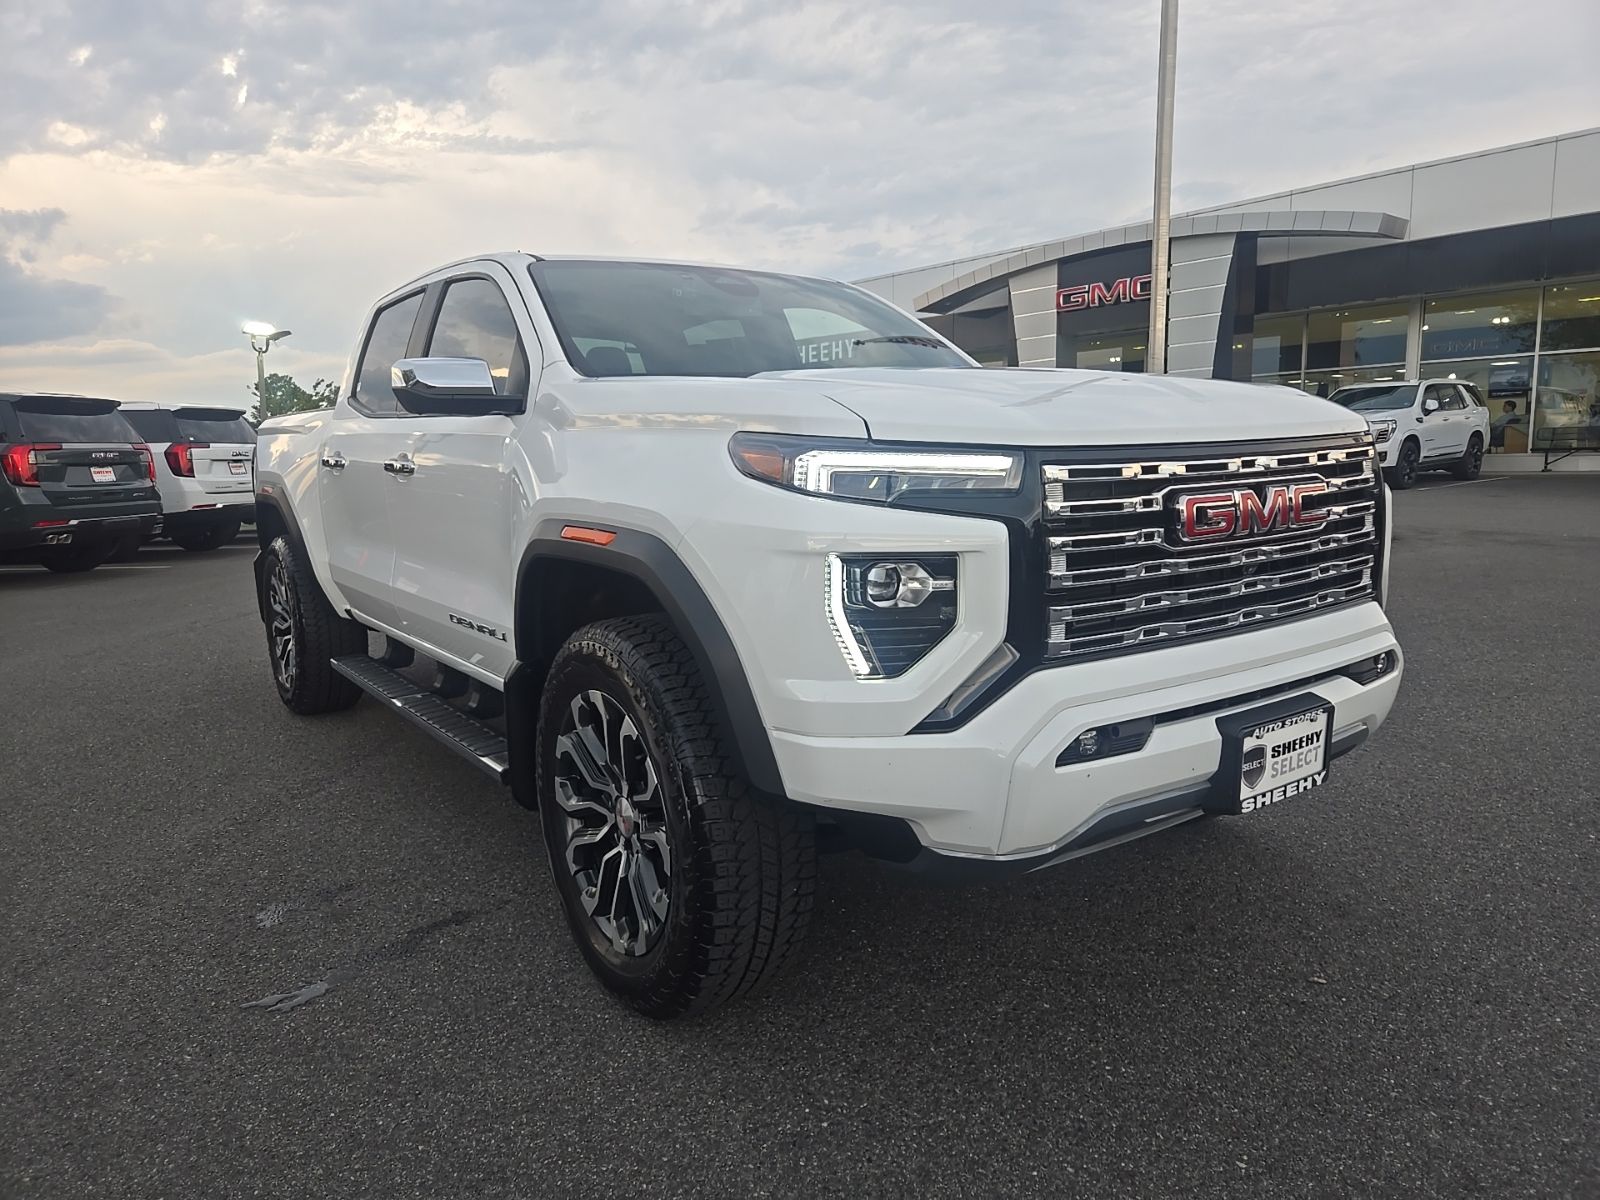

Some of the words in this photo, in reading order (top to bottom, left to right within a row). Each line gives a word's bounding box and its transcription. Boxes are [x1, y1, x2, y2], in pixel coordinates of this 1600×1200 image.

[1056, 274, 1152, 312] GMC
[797, 339, 855, 364] HEEHY
[1177, 482, 1329, 541] GMC
[1252, 722, 1282, 739] AUTO
[1271, 730, 1323, 759] SHEEHY
[1242, 758, 1265, 772] SELECT
[1271, 745, 1321, 779] SELECT
[1241, 769, 1327, 813] SHEEHY
